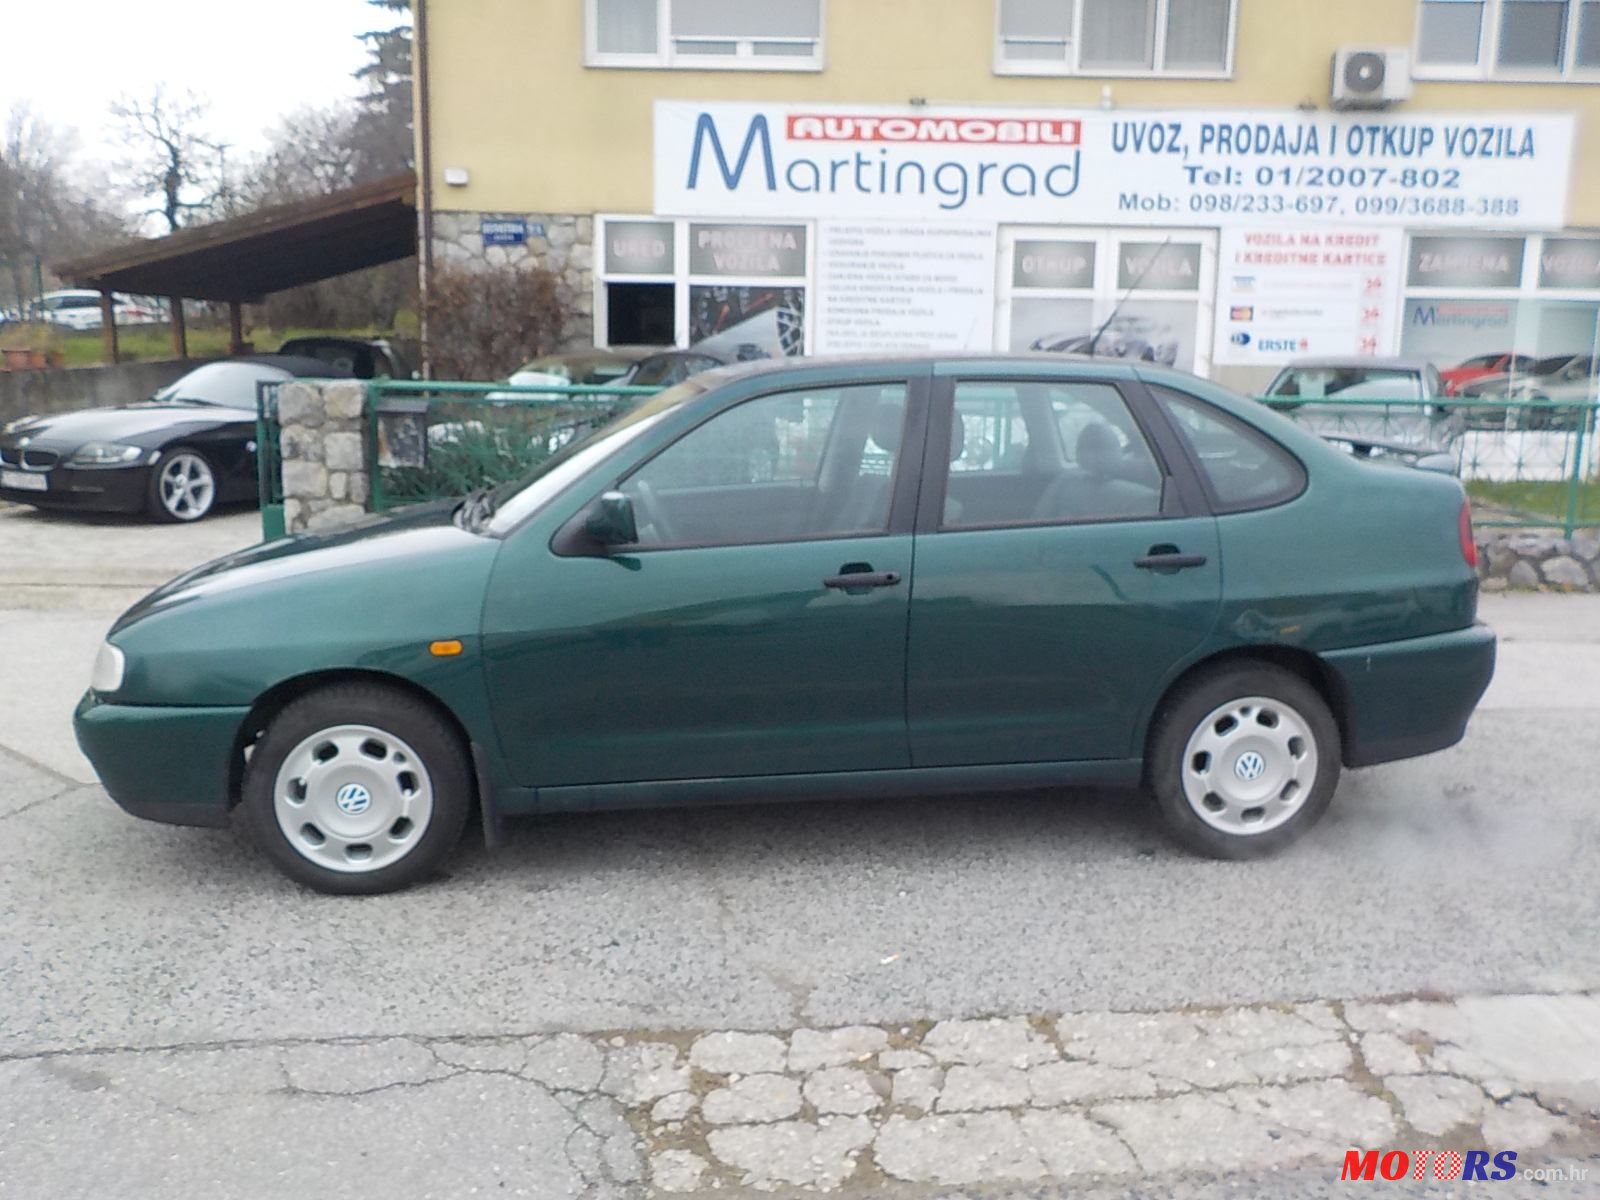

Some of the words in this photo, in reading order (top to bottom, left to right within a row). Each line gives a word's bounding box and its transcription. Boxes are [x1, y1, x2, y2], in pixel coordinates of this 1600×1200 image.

[792, 118, 1072, 142] AUTOMOBILI
[1111, 121, 1188, 159] UVOZ,
[1199, 123, 1320, 155] PRODAJA
[1328, 124, 1337, 156] I
[1346, 125, 1434, 157] OTKUP
[1444, 127, 1535, 158] VOZILA
[686, 112, 1080, 209] Martingrad
[1182, 165, 1242, 186] Tel:
[1255, 165, 1461, 189] 01/2007-802
[1118, 192, 1181, 213] Mob:
[1188, 193, 1345, 216] 098/233-697,
[1244, 232, 1296, 247] VOZILA
[1299, 233, 1320, 247] NA
[1325, 233, 1380, 248] KREDIT
[1258, 339, 1296, 352] ERSTE
